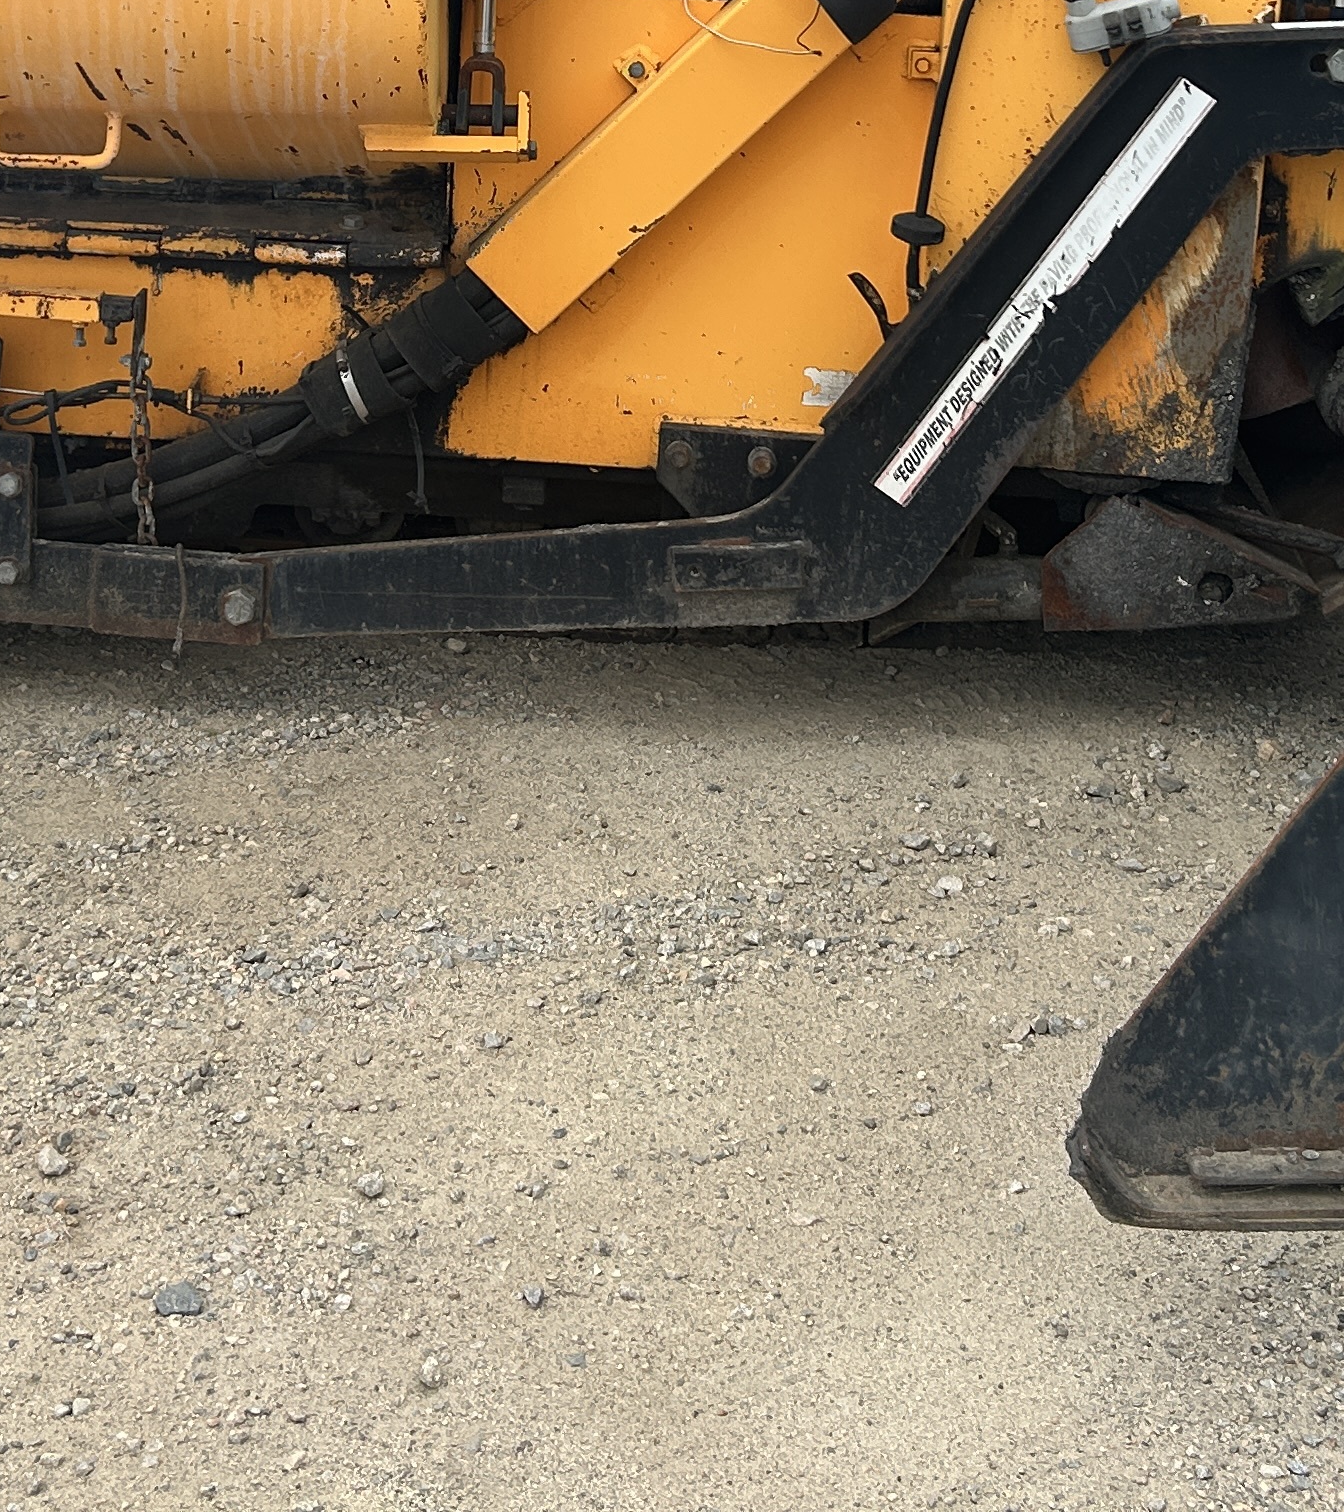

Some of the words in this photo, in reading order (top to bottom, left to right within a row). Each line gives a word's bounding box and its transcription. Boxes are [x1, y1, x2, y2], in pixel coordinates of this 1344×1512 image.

[892, 405, 953, 482] "EQUIPMENT
[947, 345, 1001, 414] DESIGNED
[1140, 135, 1162, 161] IN
